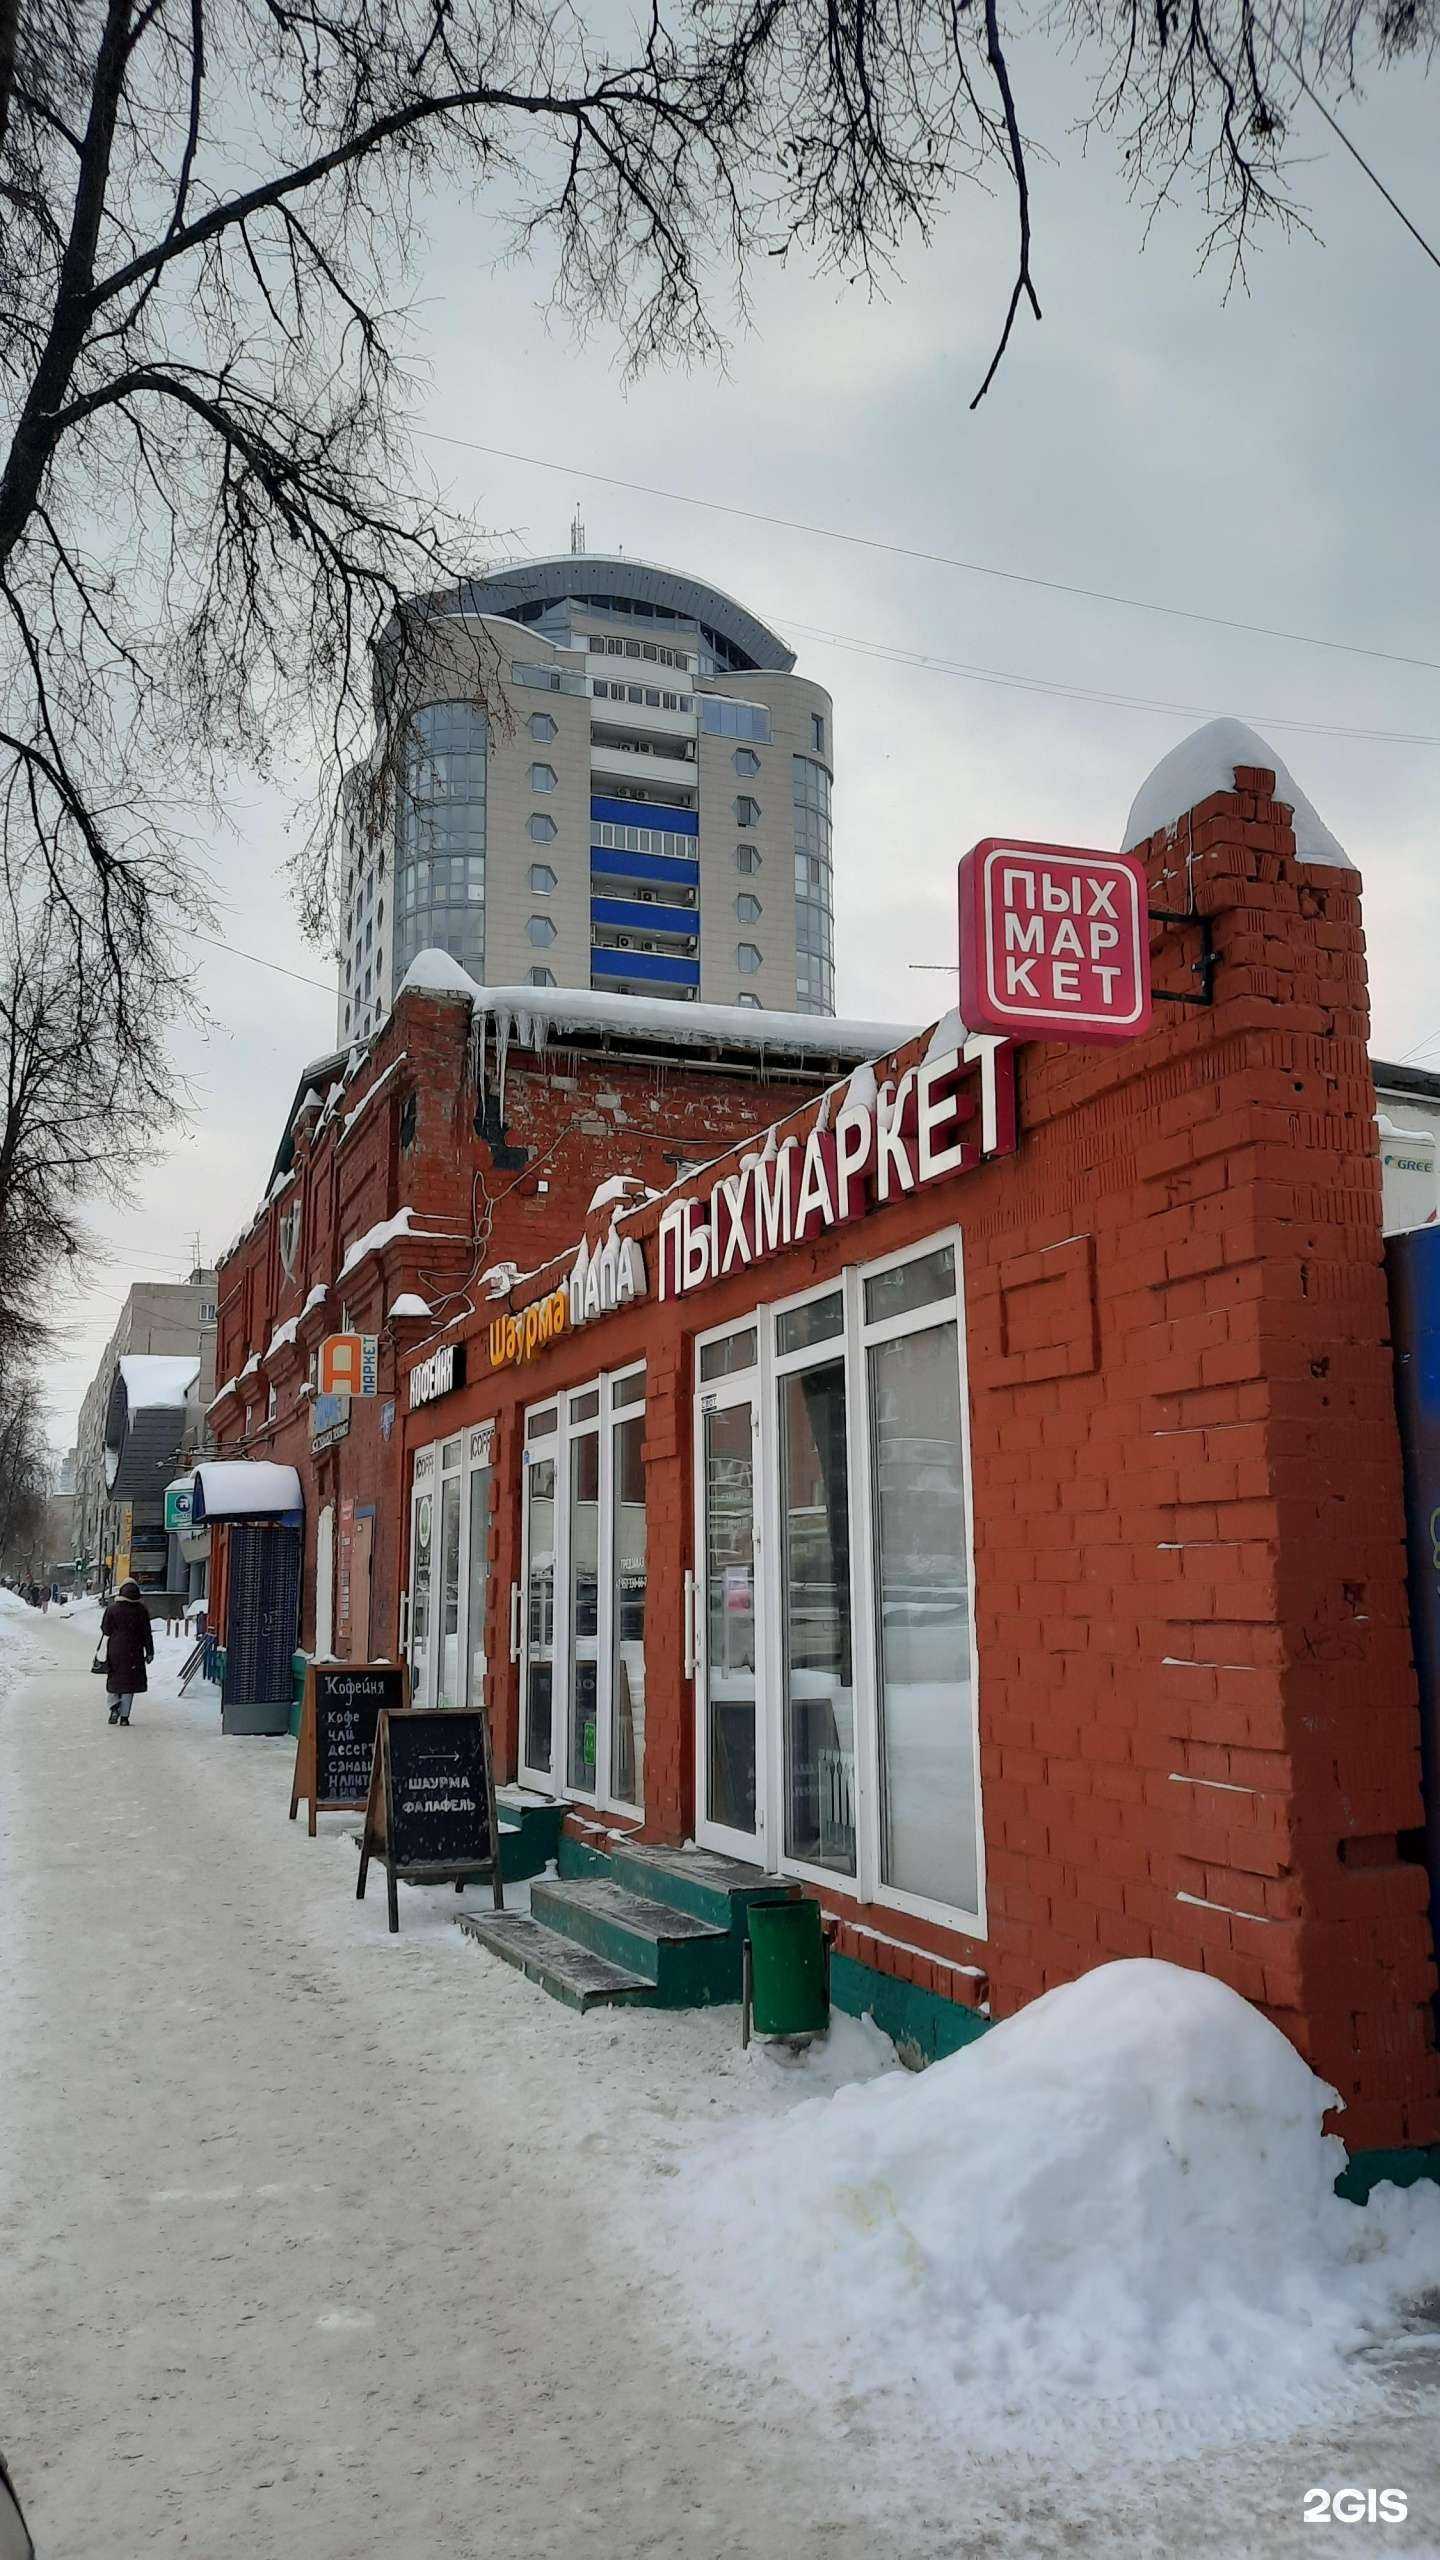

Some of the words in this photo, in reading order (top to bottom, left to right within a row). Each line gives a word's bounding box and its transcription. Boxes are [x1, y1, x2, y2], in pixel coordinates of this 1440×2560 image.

[1003, 867, 1118, 919] ПЫХ
[1004, 911, 1120, 960] МАР
[1005, 954, 1123, 1005] КЕТ
[658, 1034, 1009, 1302] ПЫХМАРКЕТ
[1397, 1159, 1433, 1173] GREE
[489, 1290, 566, 1367] Шаурма
[569, 1240, 640, 1326] ПАПА
[363, 1336, 376, 1394] МАРКЕТ
[409, 1345, 454, 1410] КОФЕЙНЯ
[324, 1675, 385, 1706] Кофейня
[402, 1795, 477, 1814] ФАЛАФЕЛЬ
[408, 1775, 471, 1791] ШАУРМА
